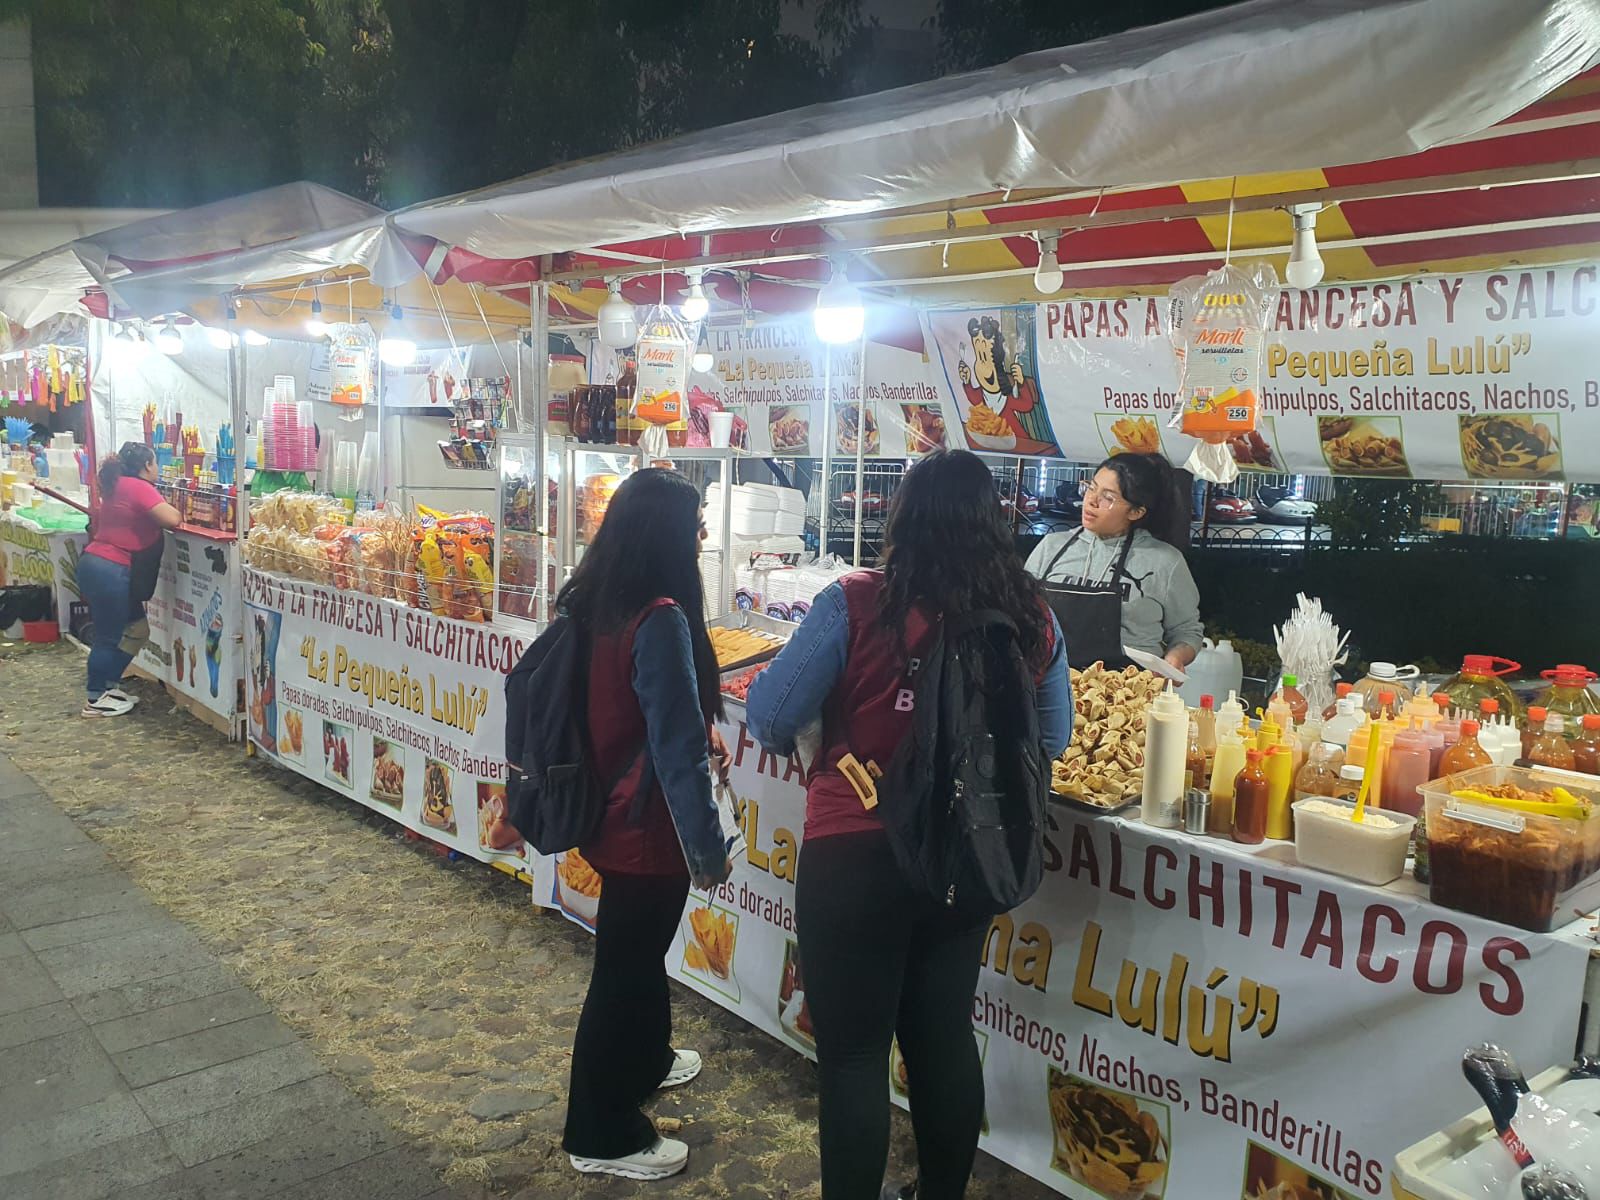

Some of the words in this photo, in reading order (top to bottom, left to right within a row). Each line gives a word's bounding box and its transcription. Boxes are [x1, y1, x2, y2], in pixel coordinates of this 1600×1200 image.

[1047, 298, 1129, 339] PAPAS
[1145, 298, 1161, 336] A
[1275, 282, 1417, 332] ANCESA
[1439, 277, 1463, 323] Y
[1486, 265, 1597, 321] SALC
[643, 346, 675, 362] Marli
[717, 330, 732, 352] LA
[1194, 327, 1247, 346] Marli
[747, 355, 814, 386] Pequeña
[1267, 339, 1415, 387] Pequeña
[881, 382, 939, 401] Banderillas
[1104, 386, 1149, 414] Papas
[1260, 386, 1344, 417] hipulpos,
[1350, 385, 1476, 414] Salchitacos,
[1484, 382, 1576, 412] Nachos,
[1228, 408, 1248, 418] 250
[291, 583, 305, 617] LA
[313, 588, 384, 638] FRANCESA
[390, 607, 399, 642] Y
[405, 612, 523, 675] SALCHITACOS
[334, 644, 425, 716] Pequeña
[894, 688, 916, 713] B
[281, 680, 301, 706] Papas
[332, 699, 385, 736] Salchipulpos,
[386, 716, 432, 757] Salchitacos,
[434, 735, 460, 773] Nachos,
[1042, 812, 1533, 1017] SALCHITACOS
[1079, 1033, 1191, 1113] Nachos,
[1199, 1077, 1384, 1197] Banderillas
